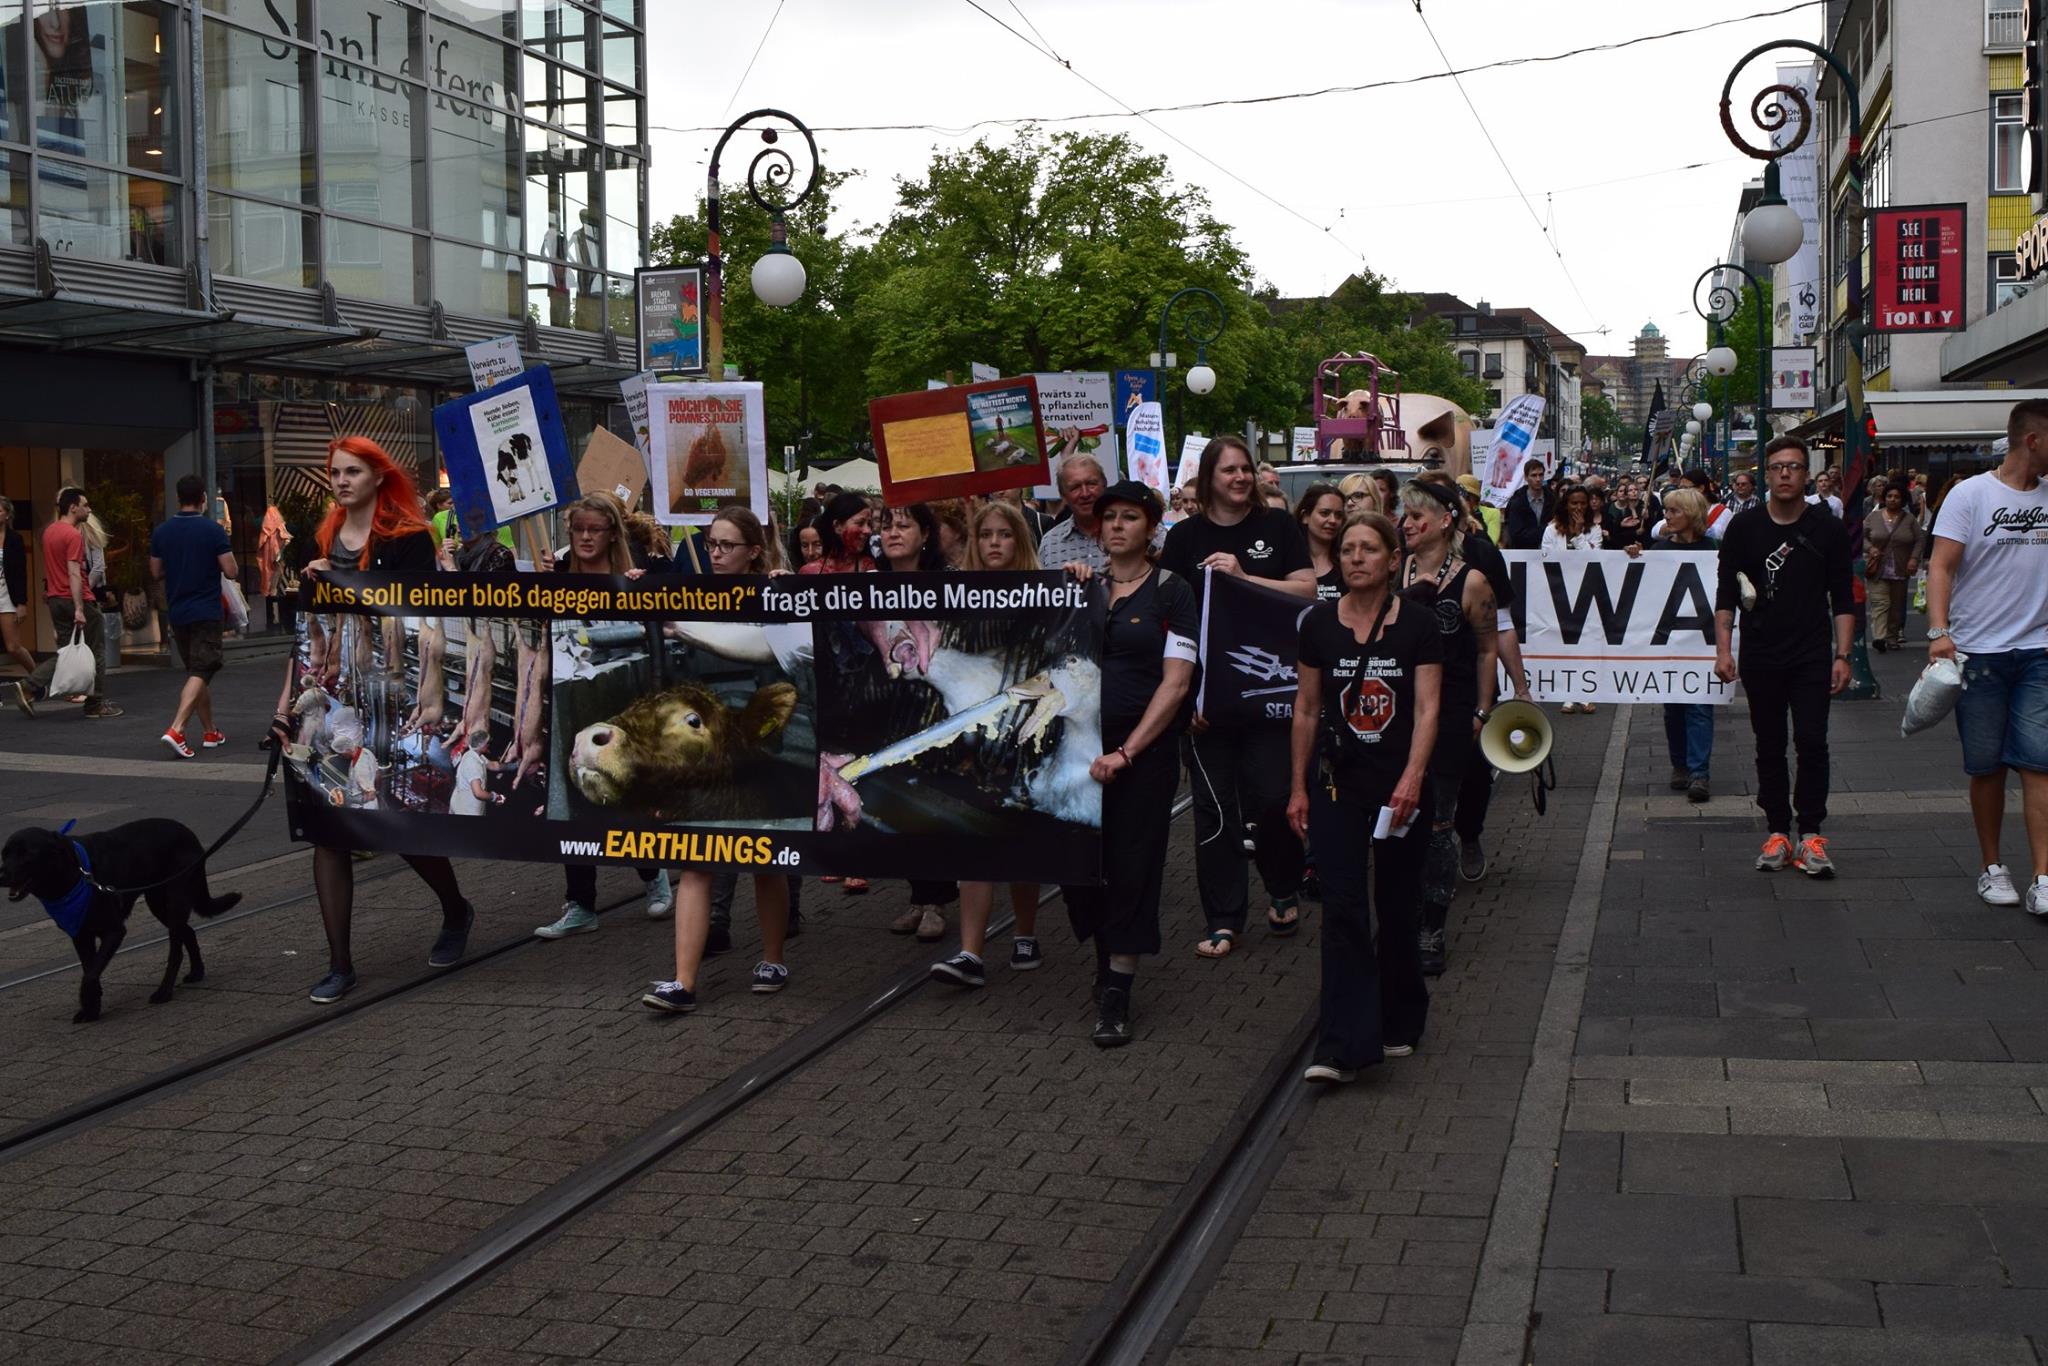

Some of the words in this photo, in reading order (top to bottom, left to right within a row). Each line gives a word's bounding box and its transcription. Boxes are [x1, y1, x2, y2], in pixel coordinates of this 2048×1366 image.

[262, 0, 495, 126] SnnLefers
[357, 103, 410, 128] KASSE
[1902, 222, 1919, 236] SEE
[1902, 244, 1925, 258] FEEL
[1902, 266, 1935, 280] TOUCH
[1902, 288, 1927, 301] HEAL
[1884, 310, 1954, 326] TOMMY
[470, 357, 498, 371] Vorwärts
[498, 357, 507, 365] zu
[1039, 390, 1072, 399] rwärts
[1074, 391, 1087, 399] zu
[668, 396, 722, 413] MÖCHTEN
[724, 399, 743, 413] SIE
[1048, 400, 1109, 412] pflanzlichen
[669, 413, 711, 424] POMMES
[713, 413, 744, 424] DAZU?
[1041, 412, 1094, 421] ternativen!
[684, 488, 694, 497] GO
[695, 488, 736, 497] VEGETARIAN!
[361, 583, 402, 606] soll
[409, 583, 466, 607] einer
[472, 584, 521, 608] bloß
[527, 585, 611, 614] dagegen
[762, 586, 820, 617] fragt
[826, 585, 863, 610] die
[869, 583, 937, 610] halbe
[944, 581, 1088, 609] Menschheit.
[1510, 561, 1718, 646] IWA
[1339, 657, 1397, 667] SCHSSUNG
[1612, 670, 1724, 695] WATCH
[1265, 702, 1294, 719] SEA
[560, 830, 801, 866] www.EARTHLINGS.de
